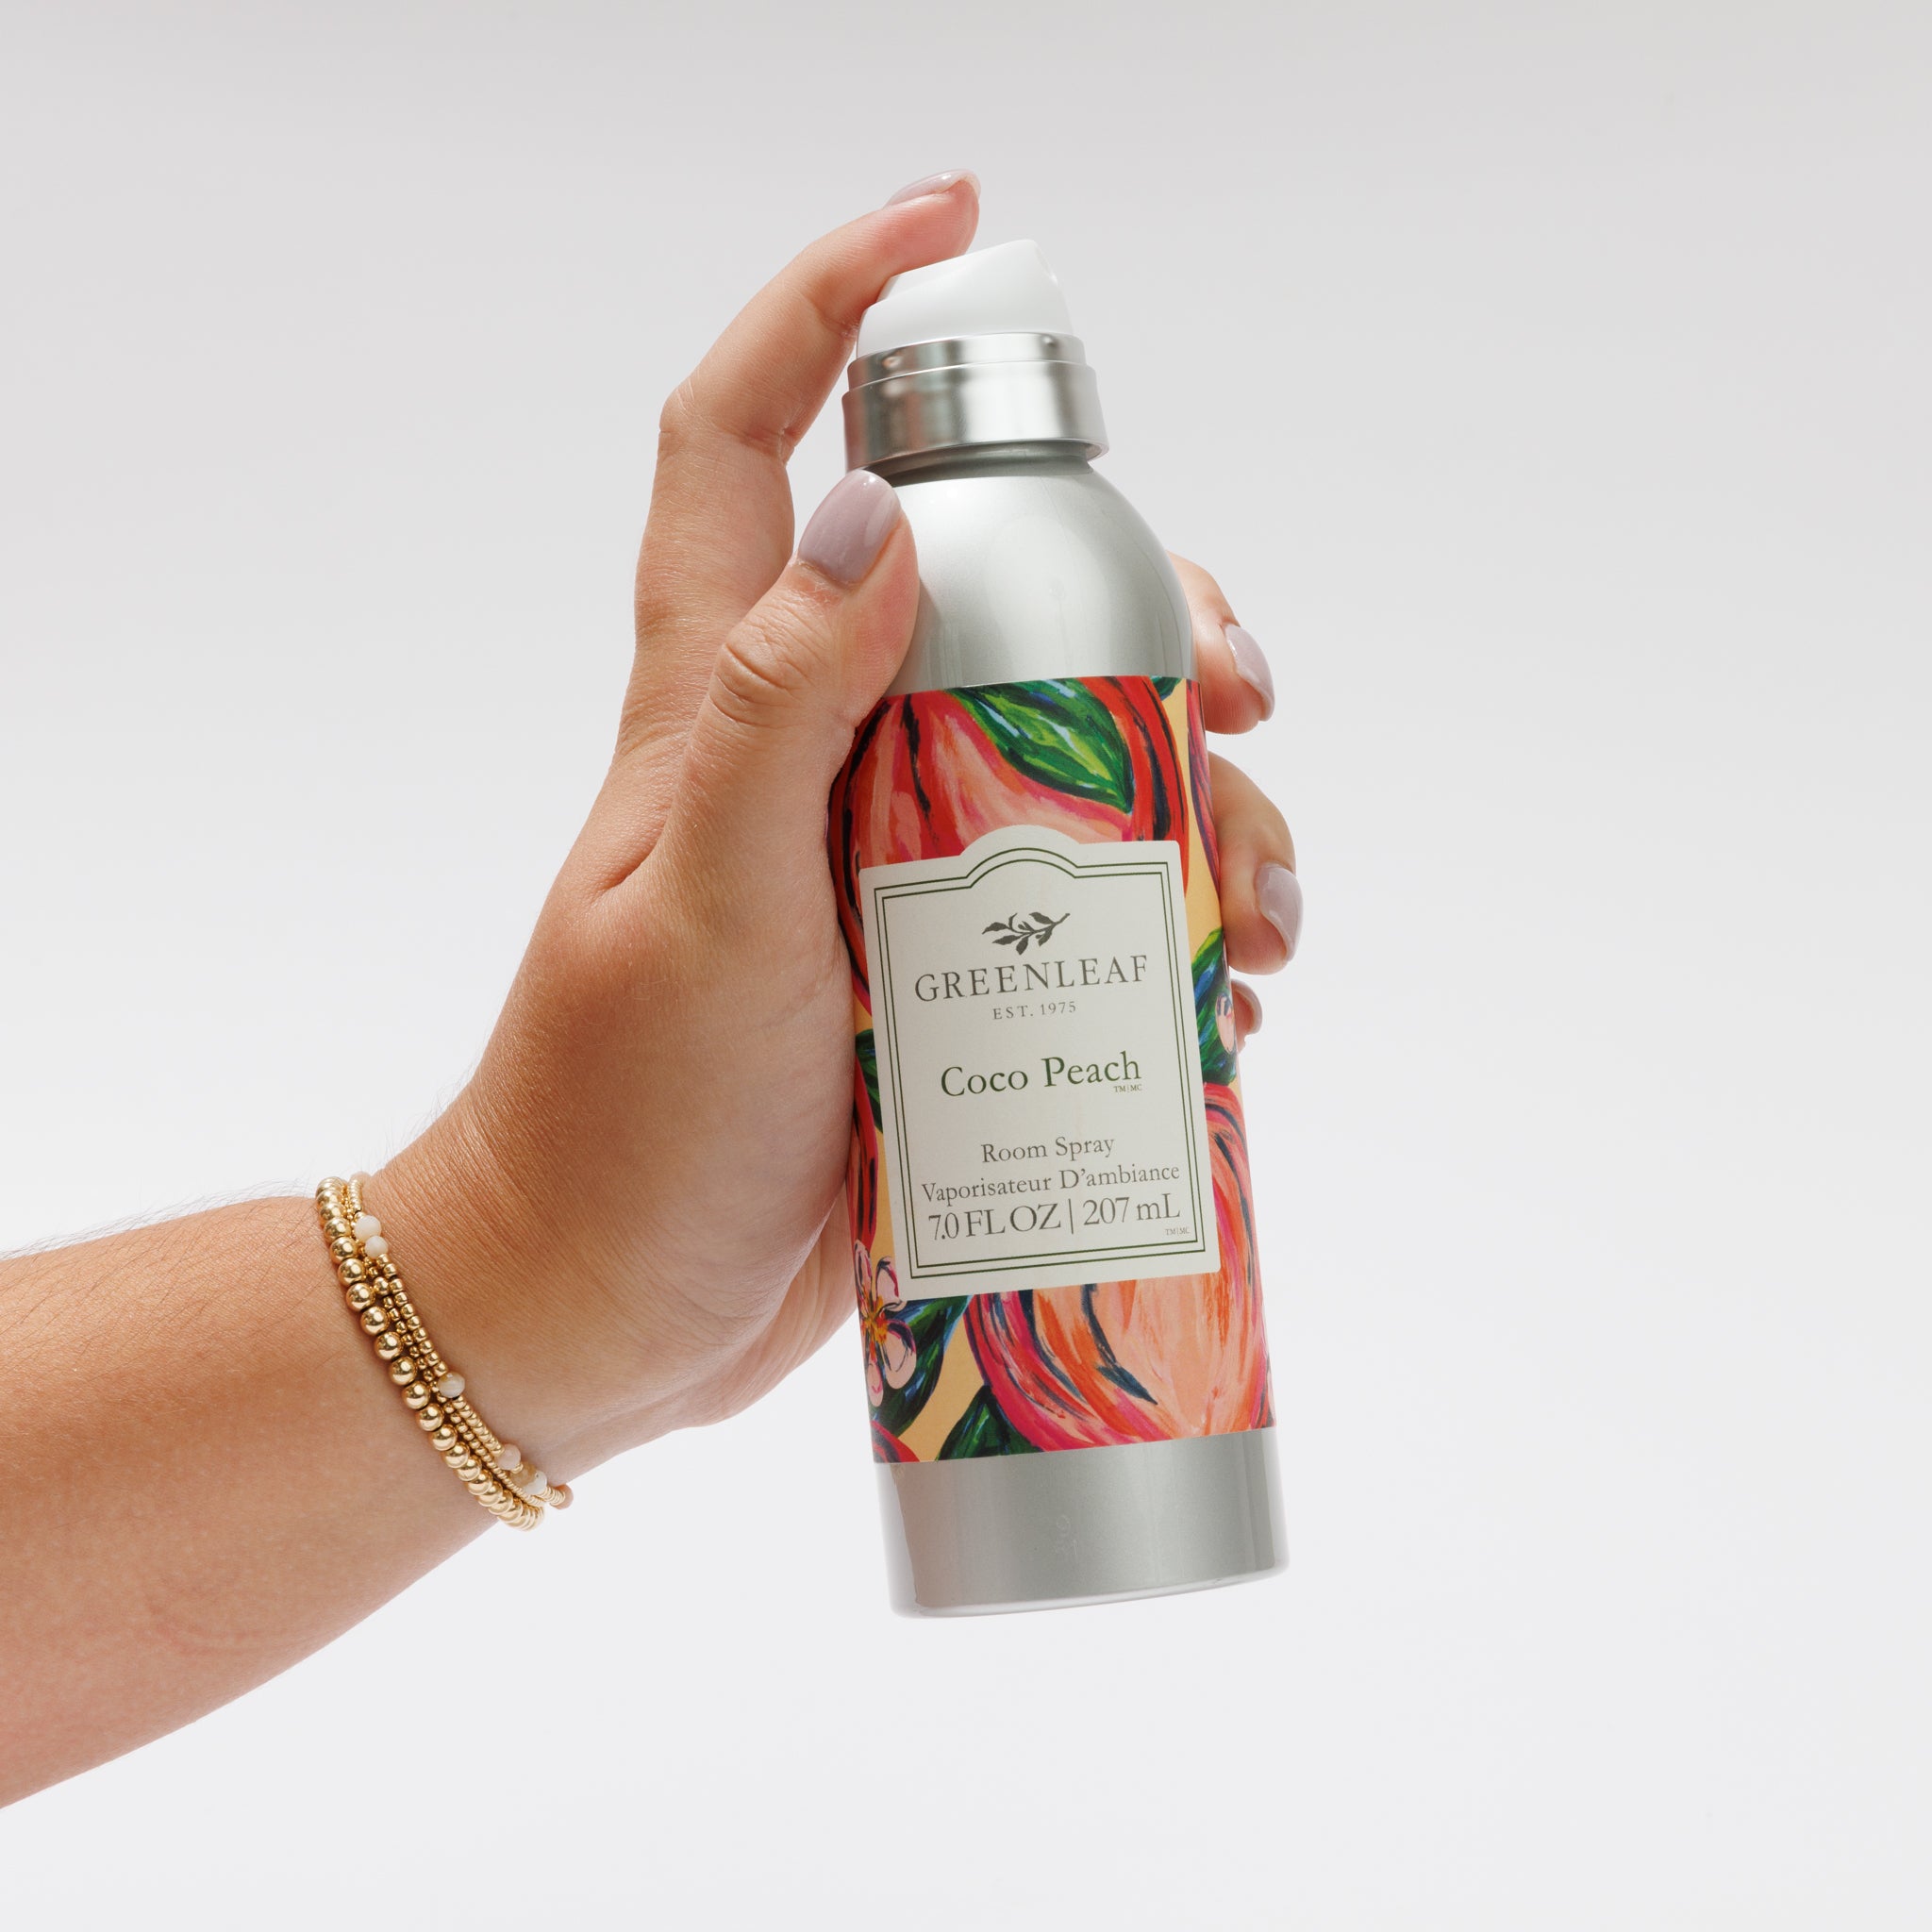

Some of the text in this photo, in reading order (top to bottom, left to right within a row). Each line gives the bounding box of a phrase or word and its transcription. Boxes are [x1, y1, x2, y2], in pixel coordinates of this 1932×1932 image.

[915, 955, 1147, 1002] GREENLEAF
[992, 1001, 1076, 1020] EST. 1975
[941, 1050, 1141, 1096] Coco Peach
[982, 1136, 1115, 1163] Room Spray
[922, 1164, 1180, 1207] Vaporisateur D’ambiance
[928, 1213, 959, 1241] 7.0
[965, 1208, 1006, 1238] FL
[1009, 1203, 1061, 1232] OZ
[1083, 1197, 1130, 1225] 207
[1136, 1192, 1180, 1221] mL
